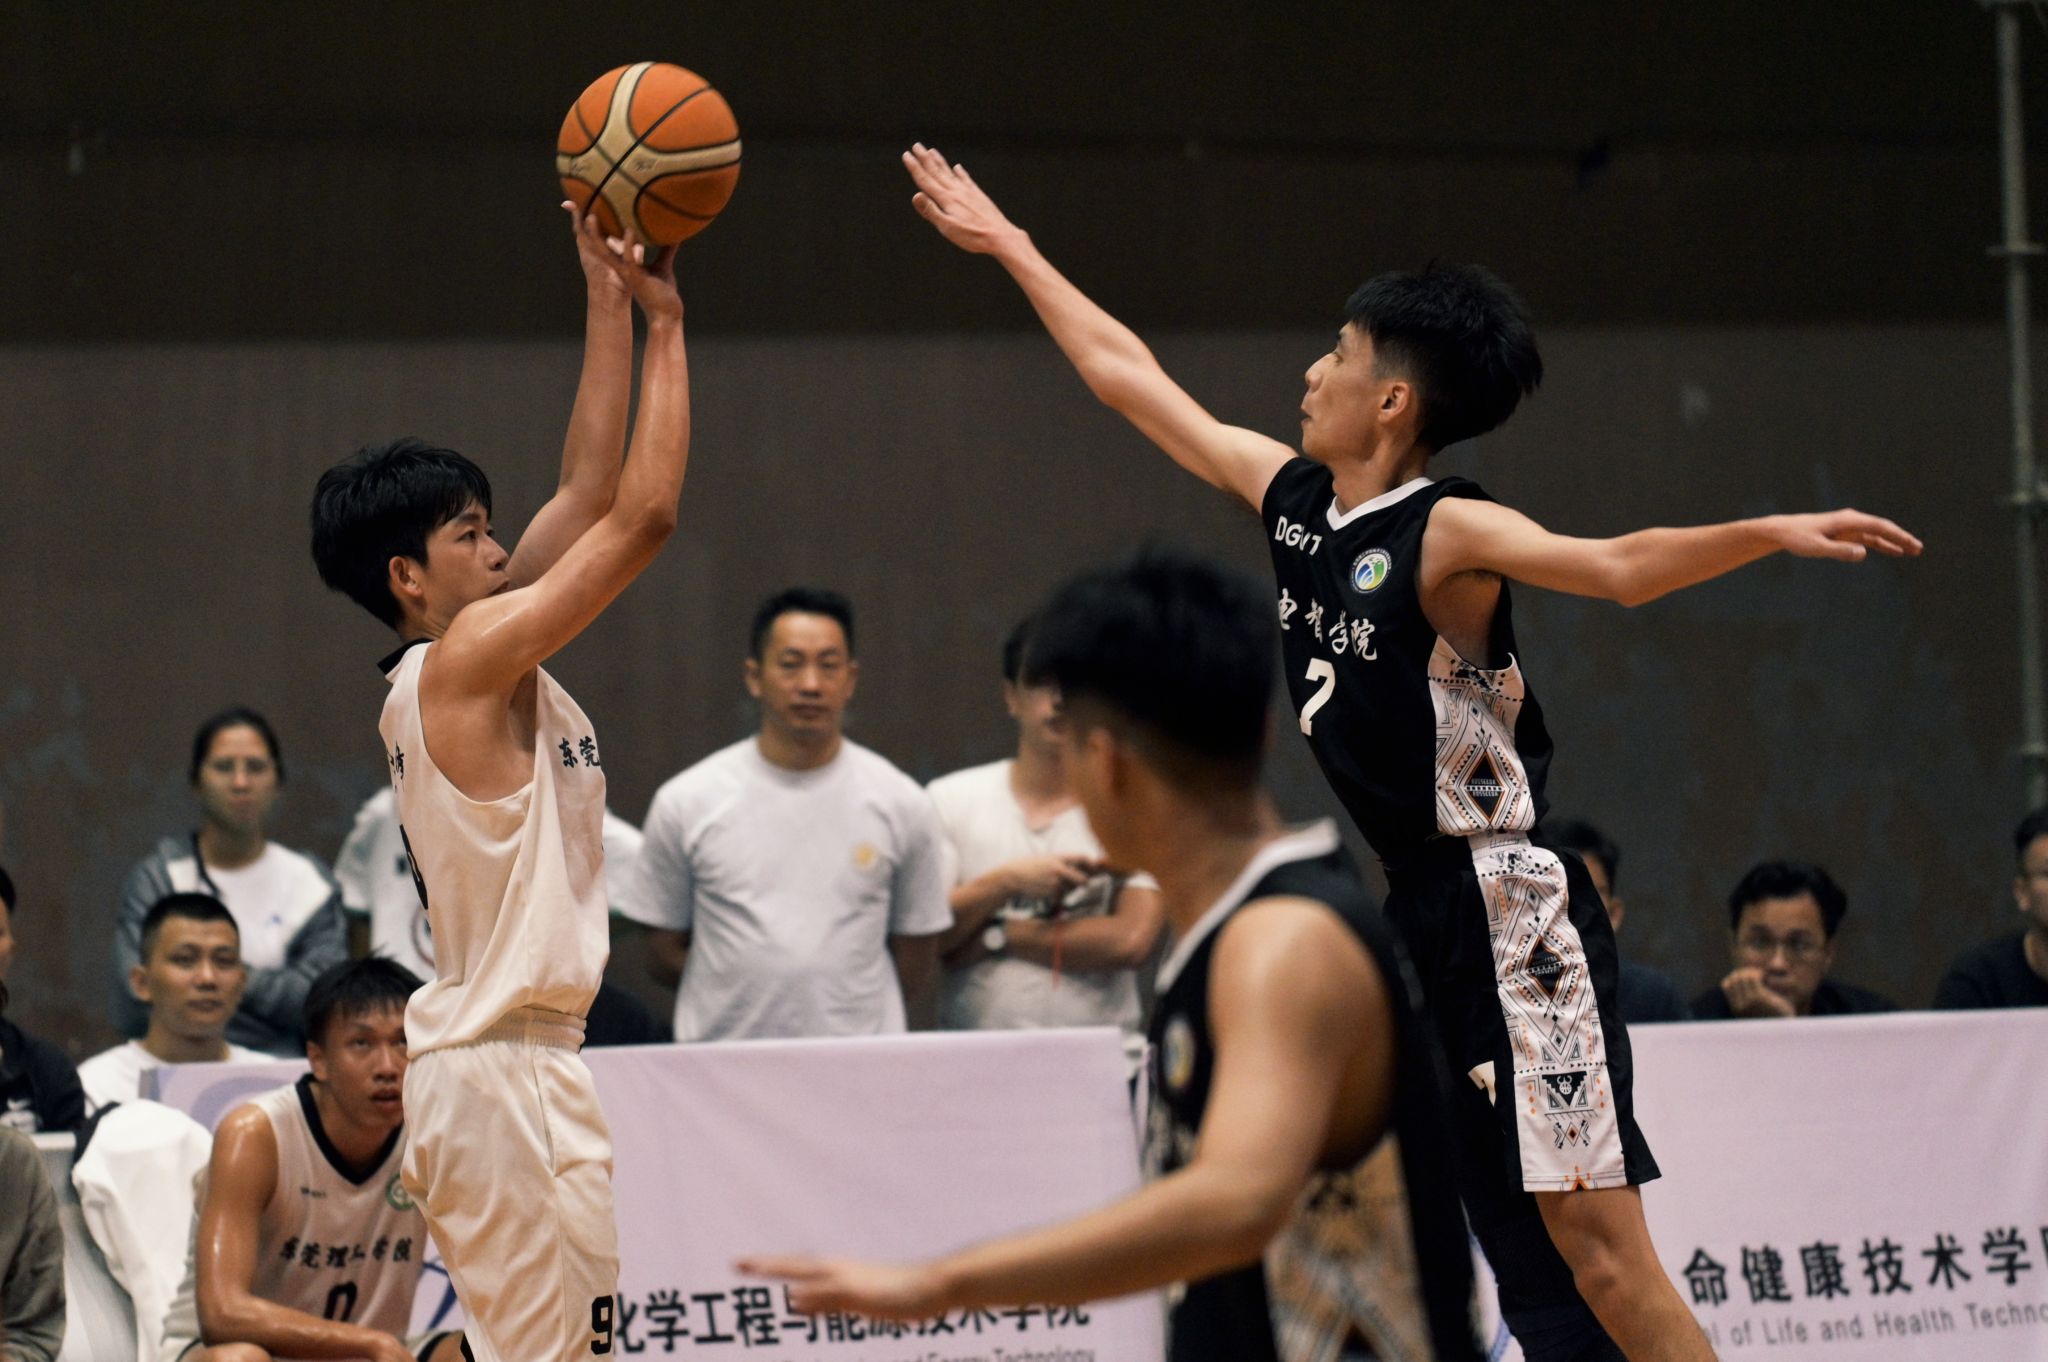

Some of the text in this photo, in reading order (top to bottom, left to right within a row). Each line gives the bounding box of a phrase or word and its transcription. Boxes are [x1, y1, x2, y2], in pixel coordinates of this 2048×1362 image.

[1299, 657, 1336, 736] 7
[558, 736, 601, 769] 东莞
[1682, 1226, 2048, 1306] 命健康技术学
[591, 1295, 613, 1354] 9
[1730, 1319, 1752, 1346] of
[1762, 1316, 1808, 1346] Life
[1820, 1313, 1863, 1342] and
[1873, 1307, 1954, 1336] Health
